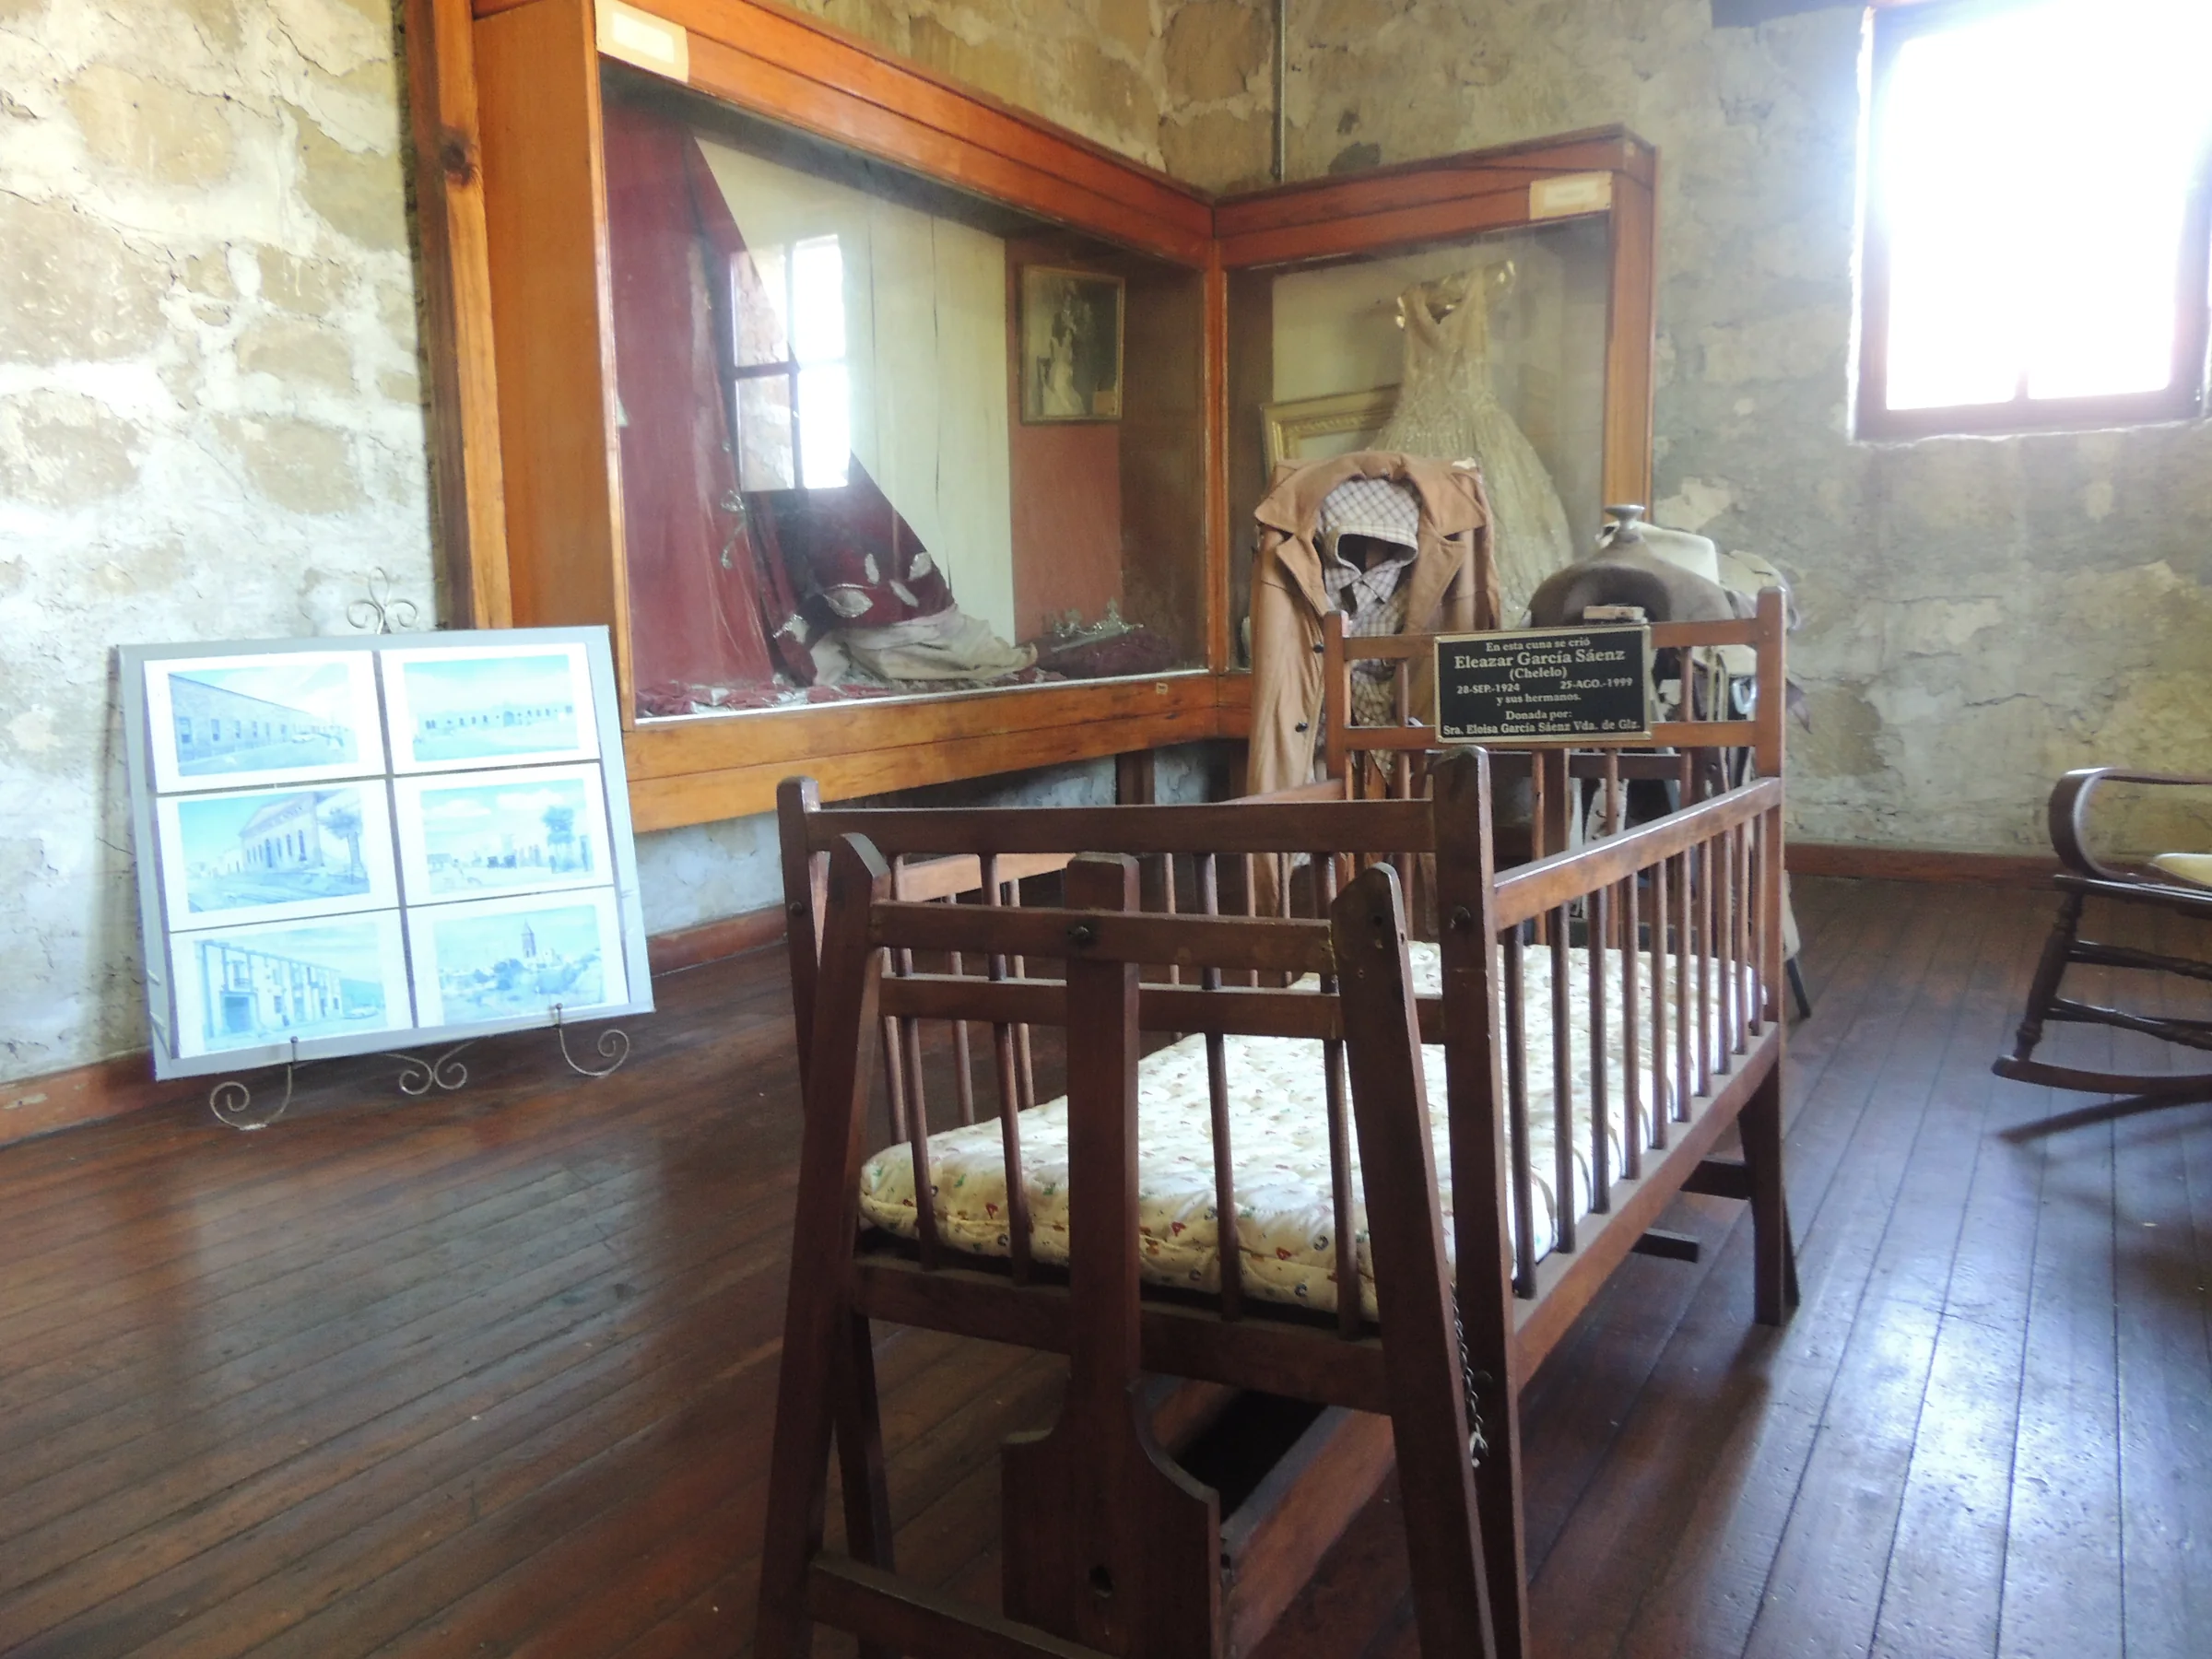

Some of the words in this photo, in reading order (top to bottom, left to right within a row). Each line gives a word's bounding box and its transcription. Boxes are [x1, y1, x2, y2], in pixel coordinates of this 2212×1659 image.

[1486, 642, 1500, 652] En
[1502, 642, 1524, 651] esta
[1555, 640, 1566, 648] se
[1569, 637, 1591, 647] crió
[1454, 654, 1513, 668] Eleazar
[1517, 650, 1572, 665] García
[1576, 648, 1626, 663] Sáenz
[1510, 666, 1567, 681] (Chelelo)
[1496, 697, 1503, 706] y
[1525, 693, 1582, 702] hermanos.
[1505, 710, 1547, 720] Donada
[1549, 711, 1572, 721] por:
[1443, 724, 1464, 735] Sra.
[1466, 724, 1499, 734] Eloisa
[1500, 723, 1535, 734] García
[1538, 722, 1571, 732] Sáenz
[1573, 720, 1598, 730] Vda.
[1602, 719, 1615, 730] de
